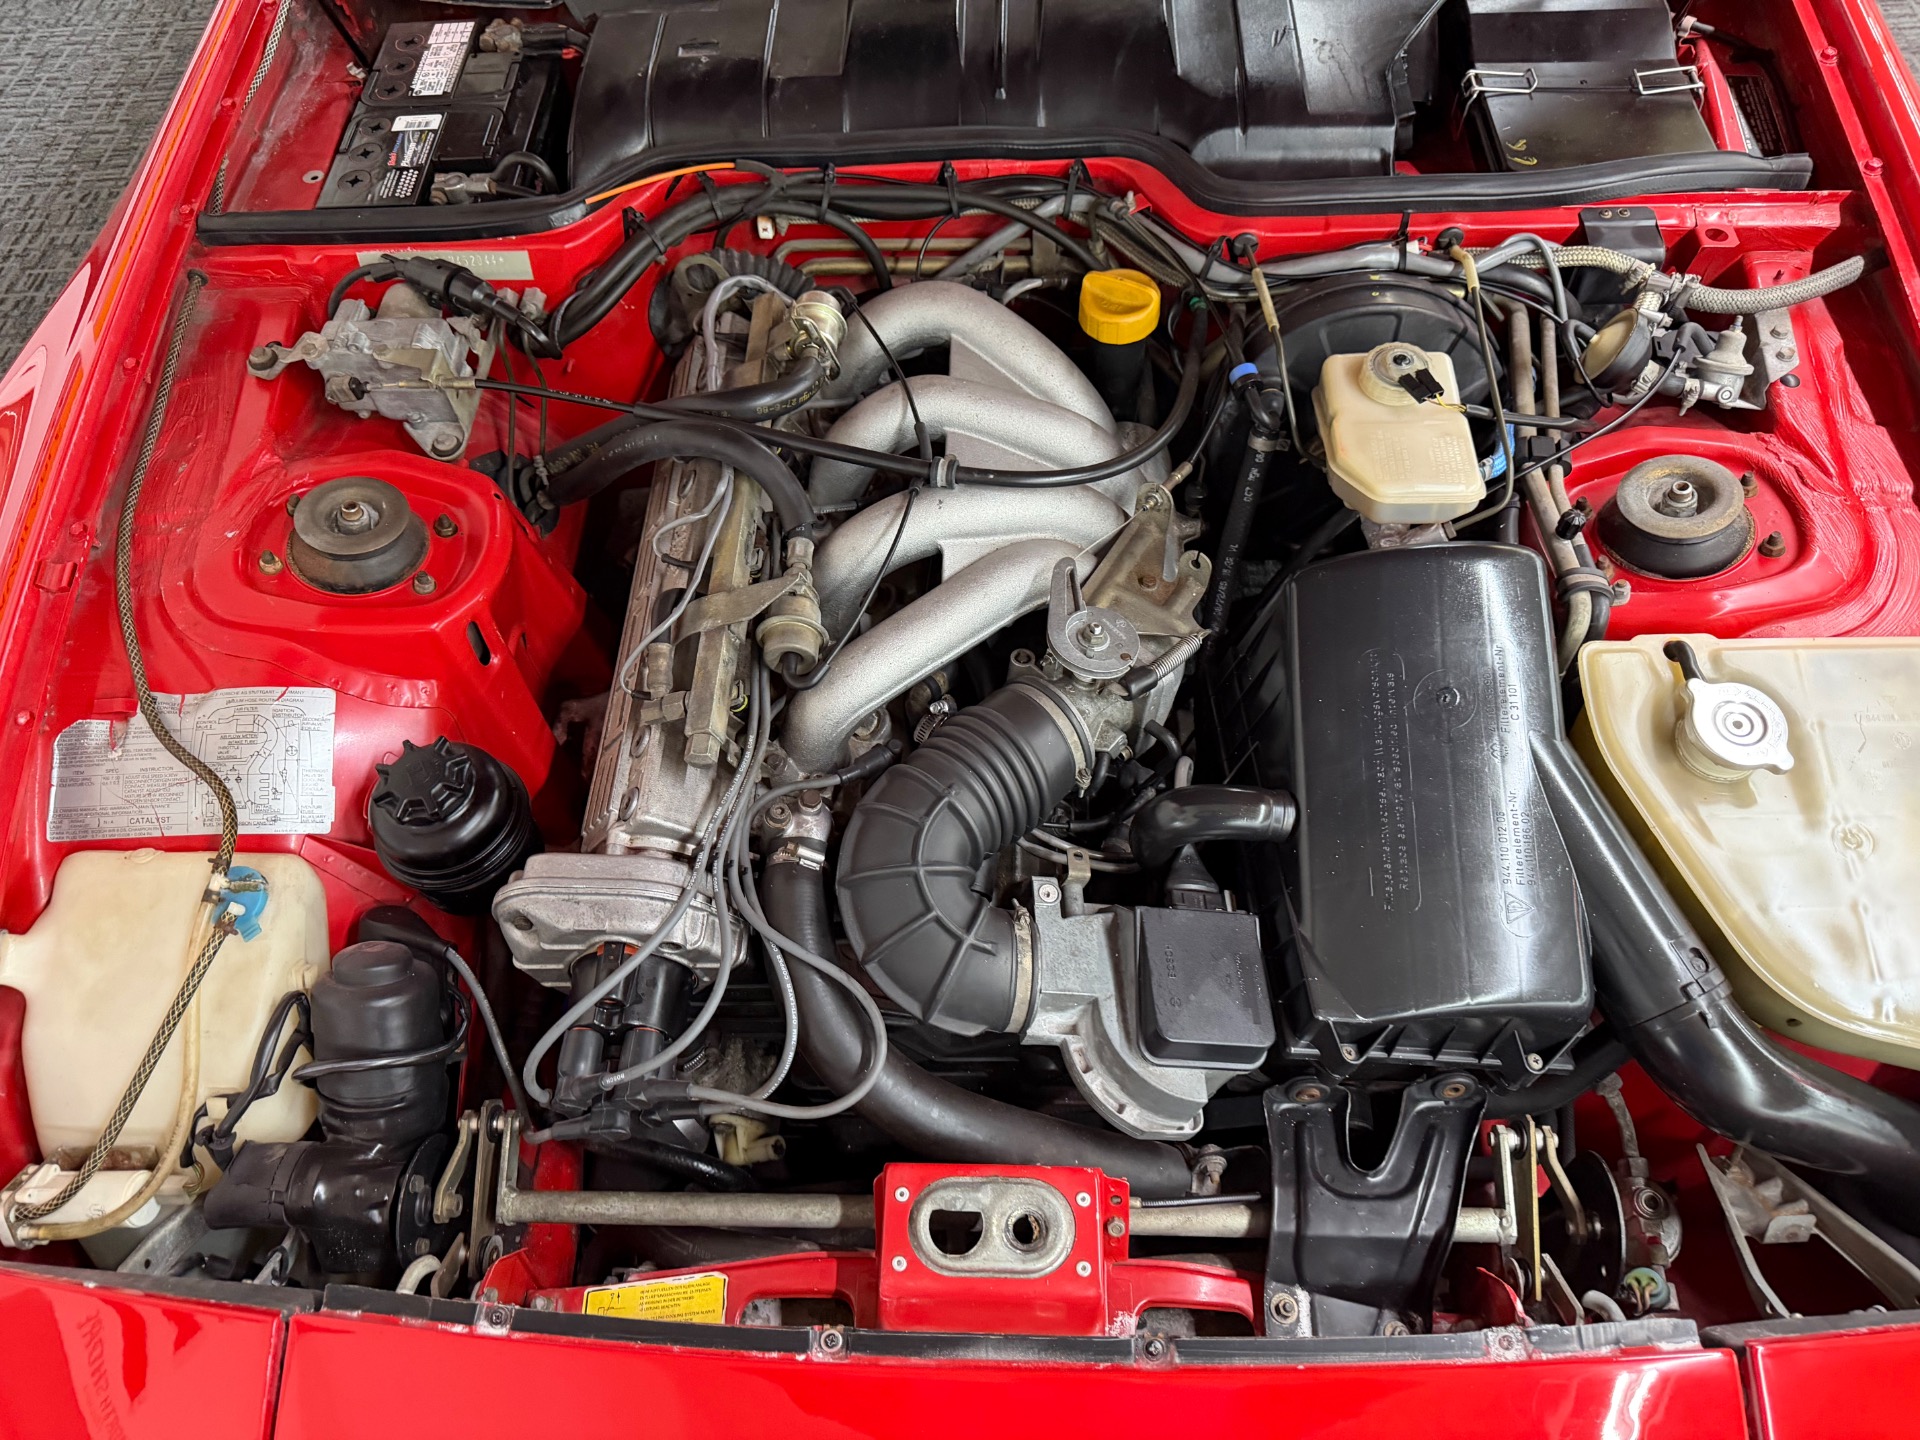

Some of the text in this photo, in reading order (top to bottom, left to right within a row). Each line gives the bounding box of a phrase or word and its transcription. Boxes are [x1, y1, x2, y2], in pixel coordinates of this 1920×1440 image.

[400, 142, 417, 167] Platinum
[1494, 642, 1510, 733] Filterelement-Nr.
[1508, 684, 1519, 721] C 31 101
[129, 816, 171, 825] CATALYST
[1507, 788, 1525, 886] Filterelement-Nr.
[776, 954, 789, 980] COPPER
[786, 984, 798, 1025] OPTI-LAYER
[791, 1028, 799, 1046] 7MM
